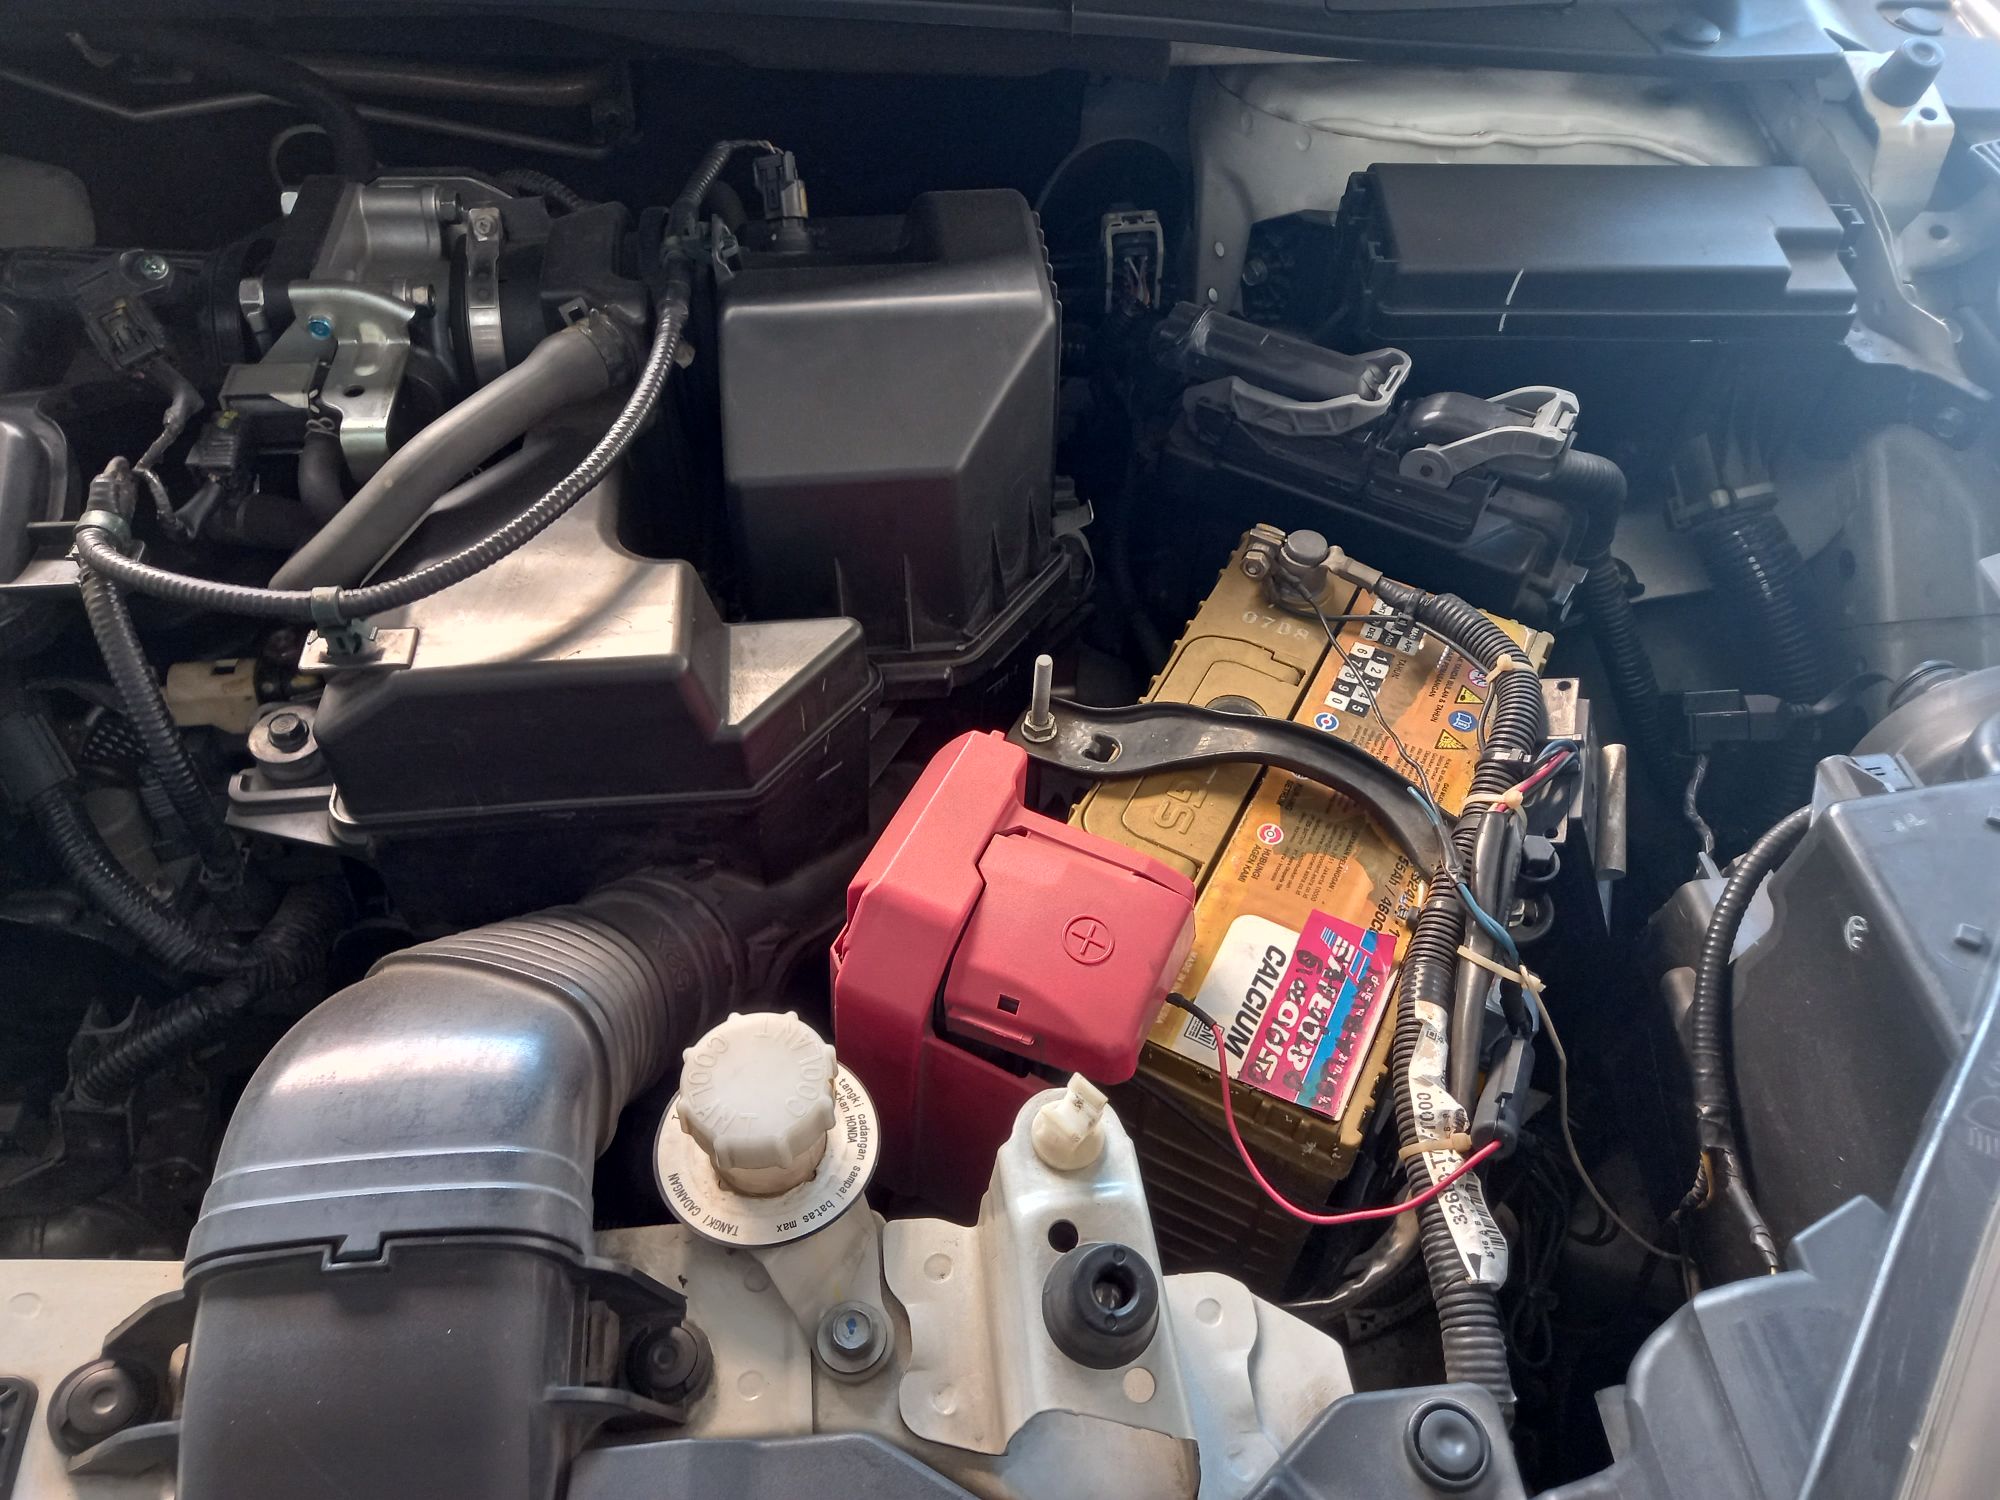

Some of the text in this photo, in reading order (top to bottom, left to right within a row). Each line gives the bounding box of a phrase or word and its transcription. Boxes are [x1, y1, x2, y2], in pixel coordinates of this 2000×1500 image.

[1365, 626, 1375, 639] DES
[1356, 646, 1367, 656] 6
[1369, 665, 1381, 675] 2
[1337, 683, 1349, 693] 9
[1363, 677, 1376, 688] 3
[1351, 703, 1363, 713] 5
[1430, 704, 1443, 722] TAHUN
[1237, 843, 1261, 883] AGEN KAMI
[1251, 848, 1271, 879] HUBUNGI
[1222, 944, 1287, 1059] CALCIUM
[845, 1115, 858, 1144] HONDA
[776, 1078, 870, 1233] tangki cadangan sampai batas max
[667, 1172, 739, 1237] TANGKI CADANGAN
